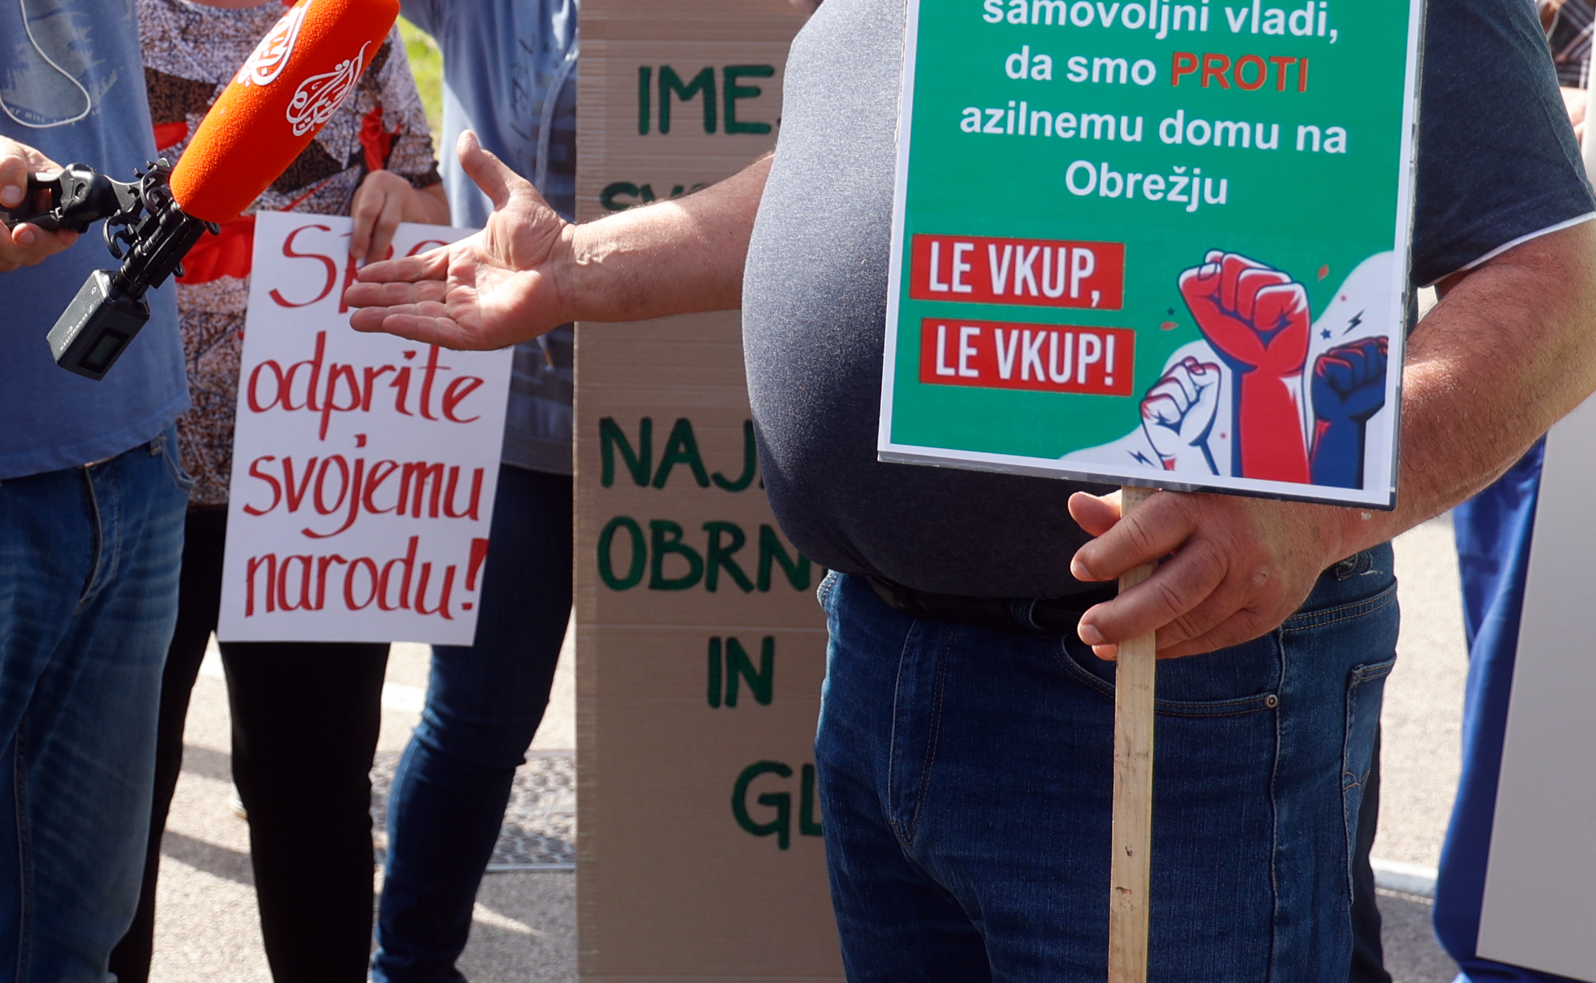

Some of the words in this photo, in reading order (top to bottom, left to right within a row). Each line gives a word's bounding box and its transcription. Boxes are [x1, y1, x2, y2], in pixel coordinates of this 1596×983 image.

[1225, 0, 1339, 42] vladi,
[1005, 46, 1053, 82] da
[1066, 58, 1157, 87] smo
[1170, 51, 1308, 93] PROTI
[959, 101, 1143, 142] azilnemu
[1158, 110, 1280, 149] domu
[1296, 123, 1347, 154] na
[1064, 159, 1228, 213] Obrežju
[929, 242, 971, 294] LE
[987, 244, 1101, 308] VKUP,
[247, 331, 484, 441] odprite
[936, 326, 978, 377] LE
[994, 328, 1116, 387] VKUP!
[243, 434, 484, 539] svojemu
[598, 417, 766, 493] NAJ
[244, 535, 488, 620] narodu!
[708, 635, 774, 708] IN
